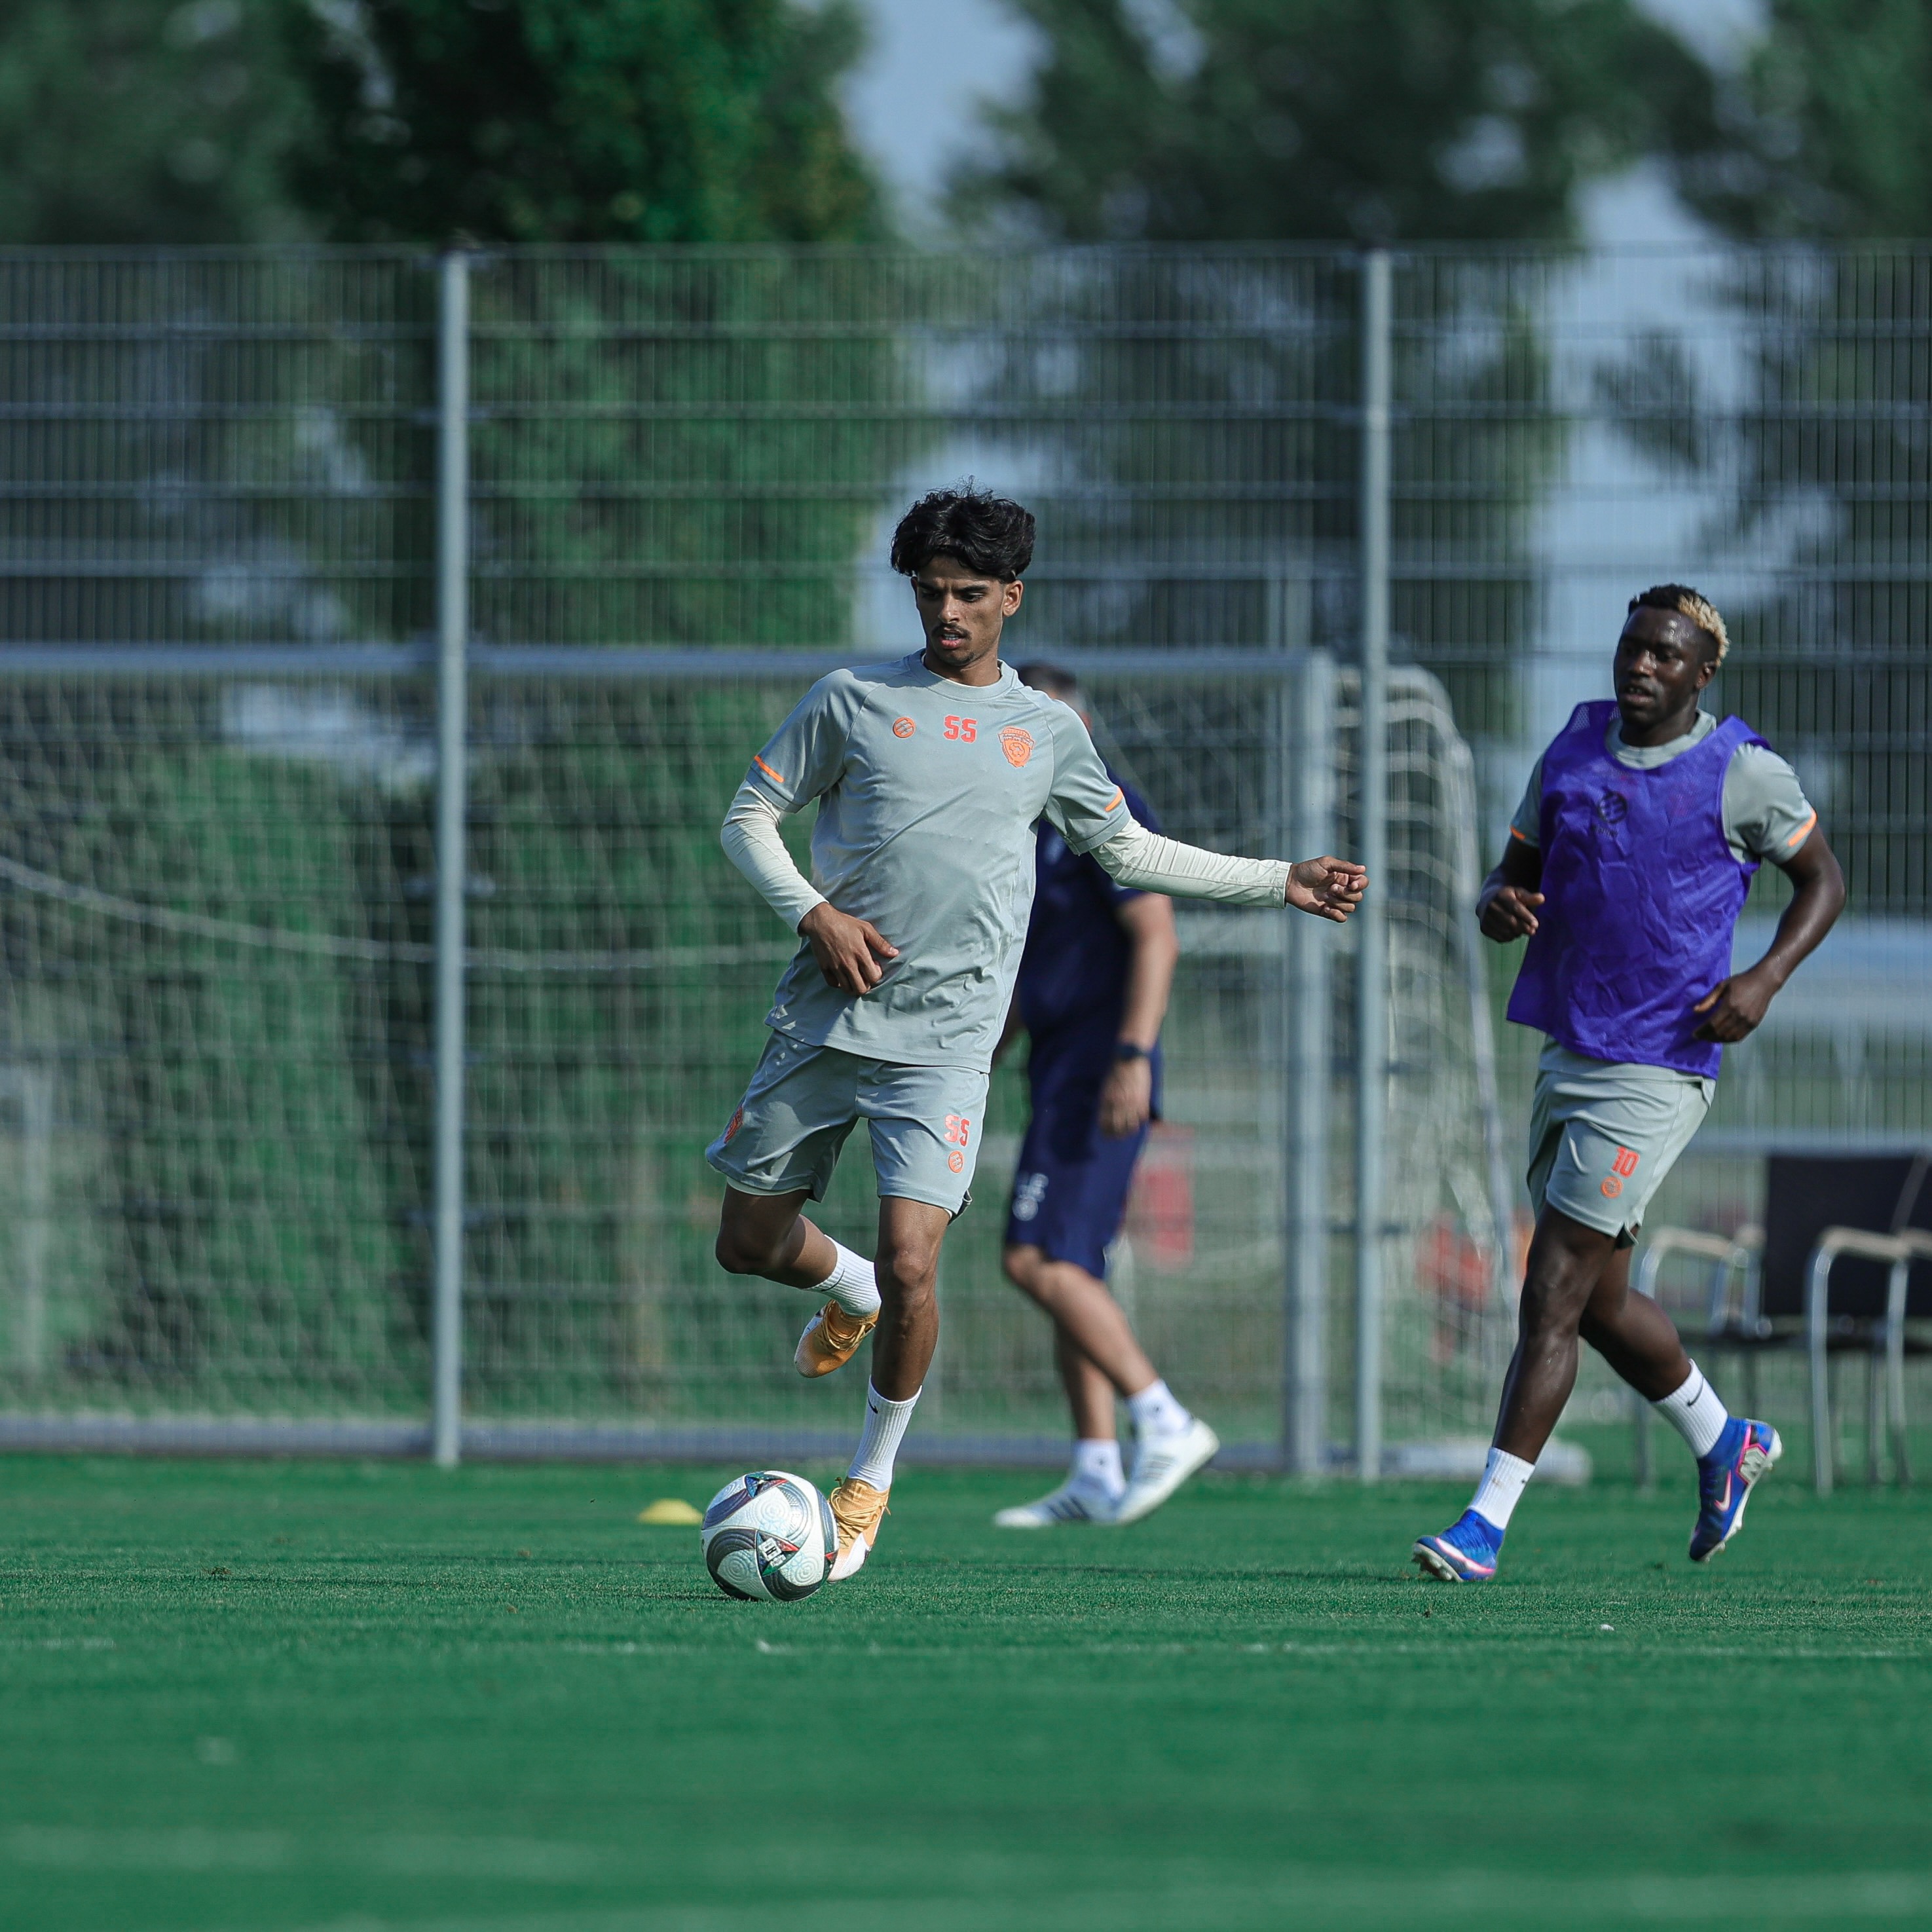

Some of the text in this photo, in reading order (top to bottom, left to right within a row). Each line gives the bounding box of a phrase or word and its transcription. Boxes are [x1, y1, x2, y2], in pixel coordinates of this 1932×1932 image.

[943, 715, 977, 743] 55
[944, 1114, 971, 1147] 55
[1611, 1145, 1640, 1178] 10
